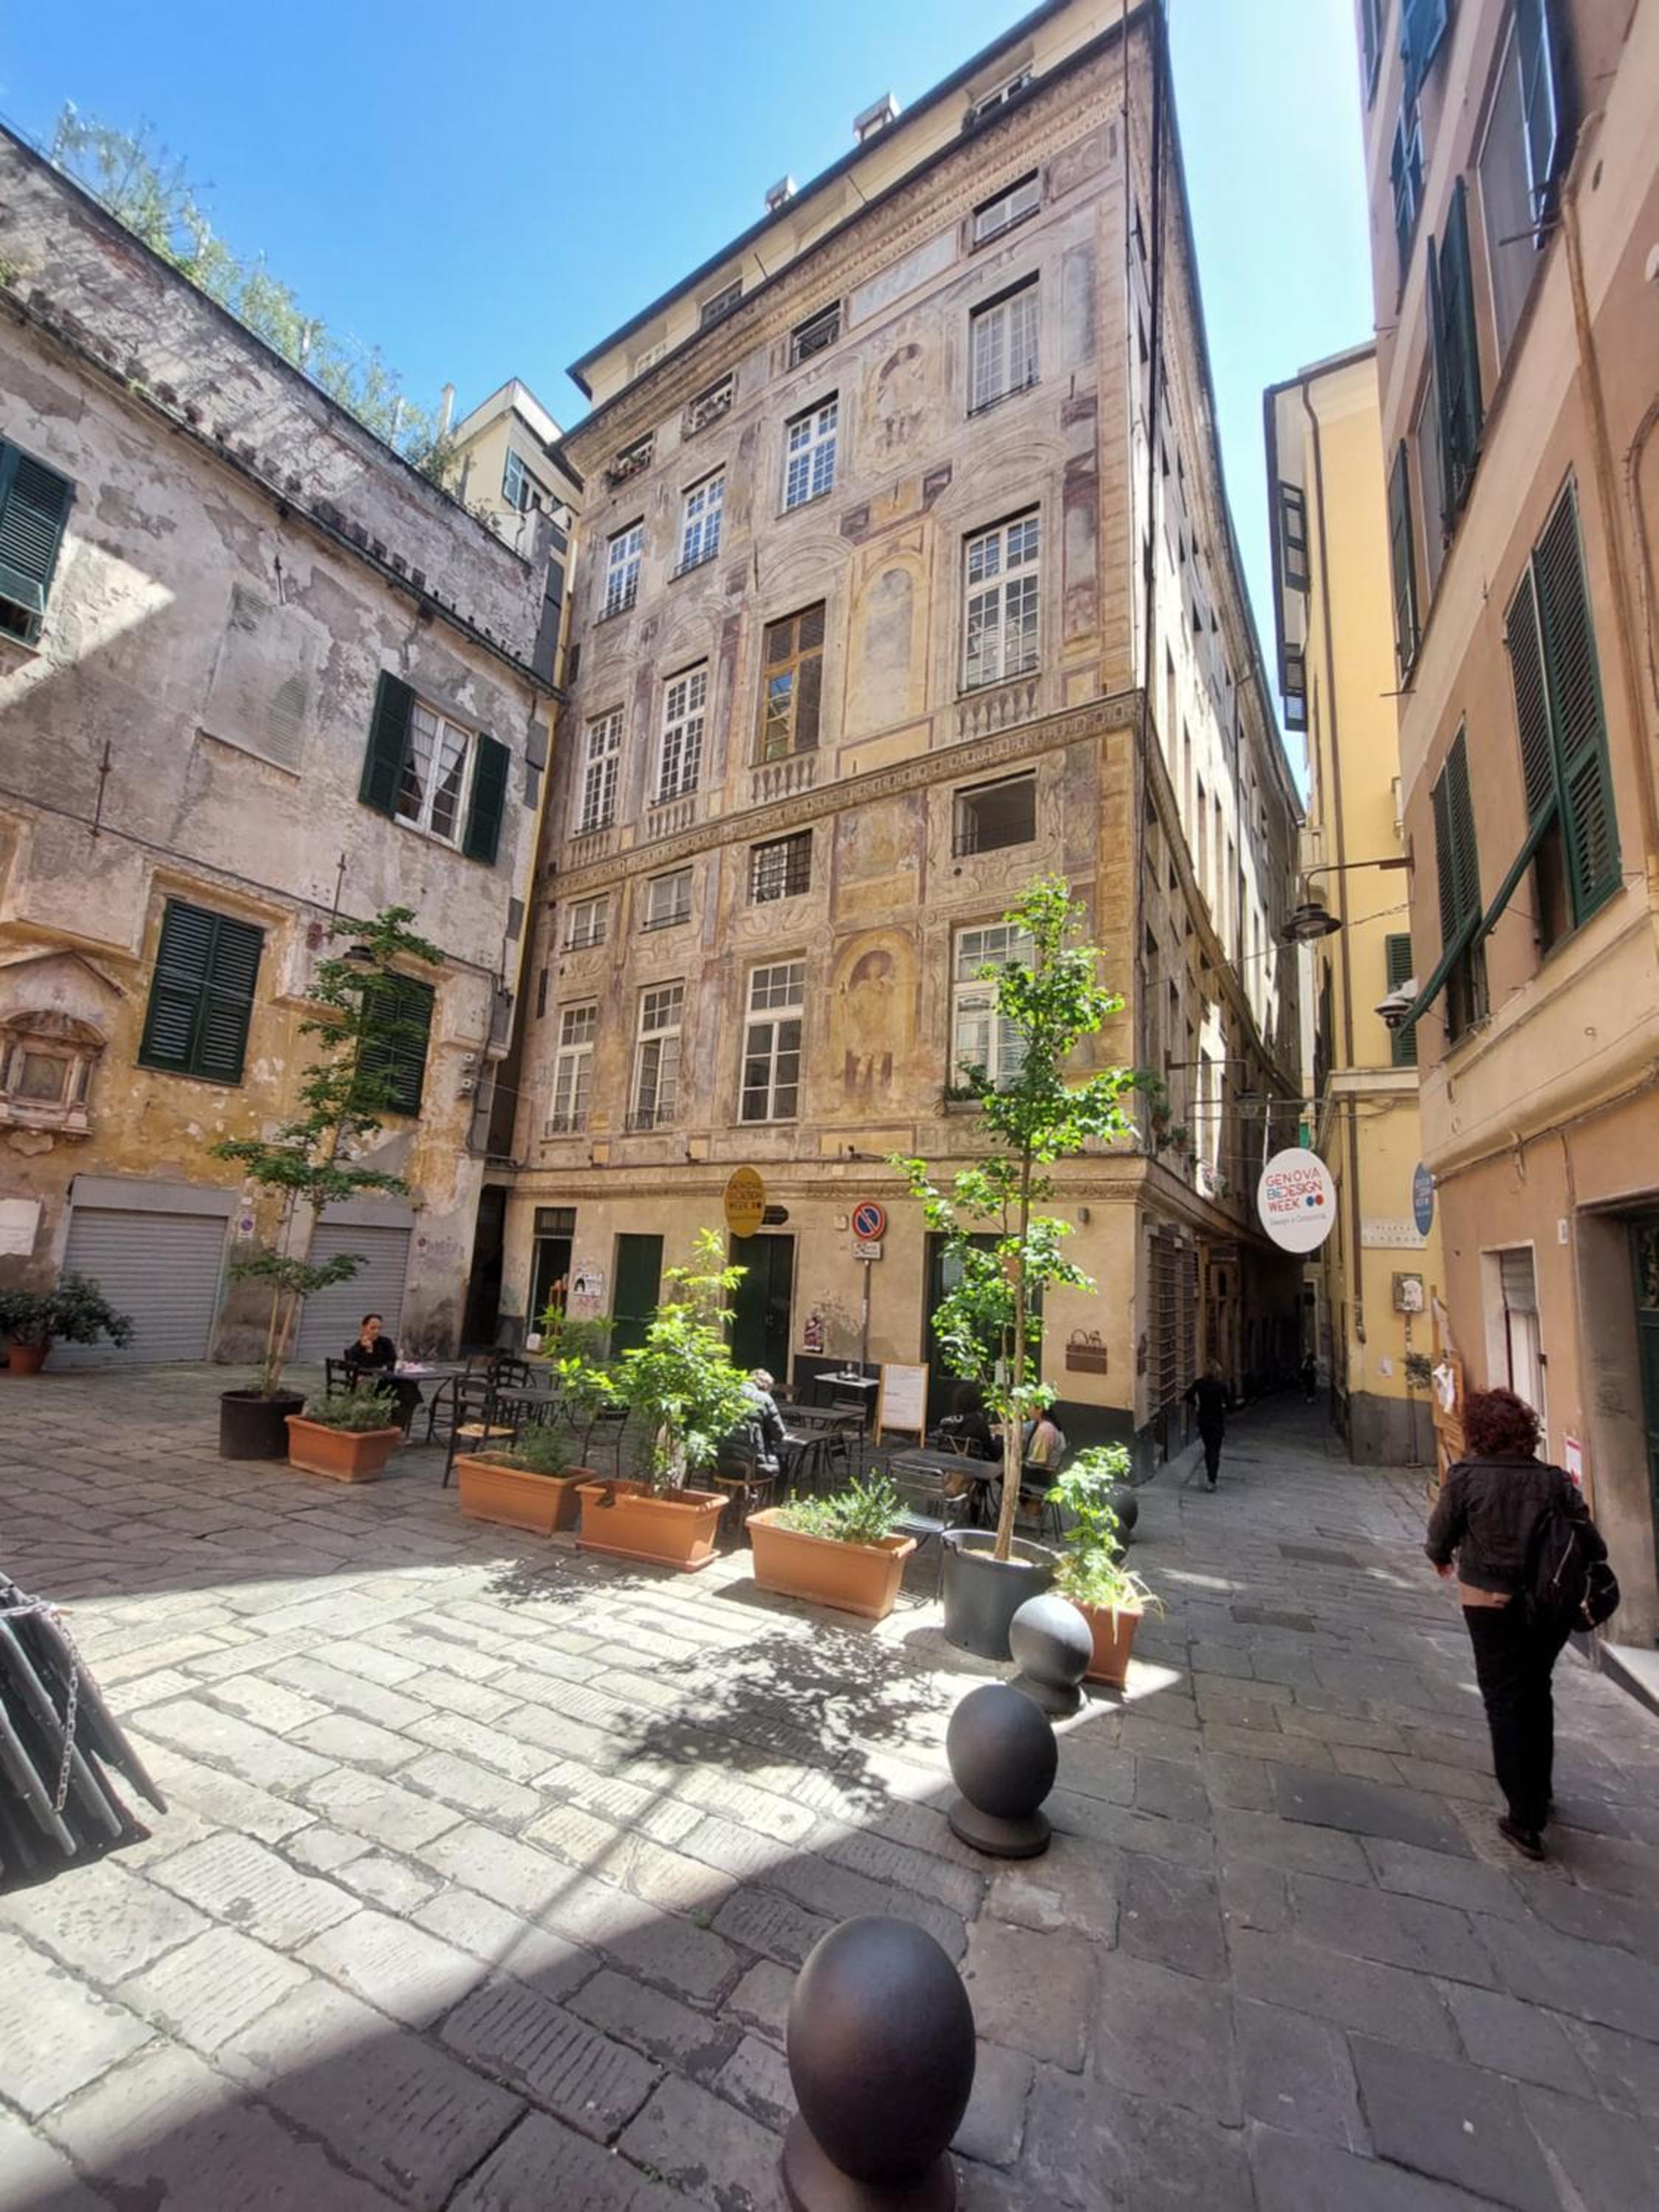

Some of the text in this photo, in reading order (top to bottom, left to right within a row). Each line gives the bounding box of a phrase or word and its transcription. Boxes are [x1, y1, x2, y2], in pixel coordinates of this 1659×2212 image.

[1265, 1167, 1321, 1187] GENOVA
[1266, 1180, 1323, 1200] BEDESIGN
[1267, 1197, 1301, 1213] WEEK
